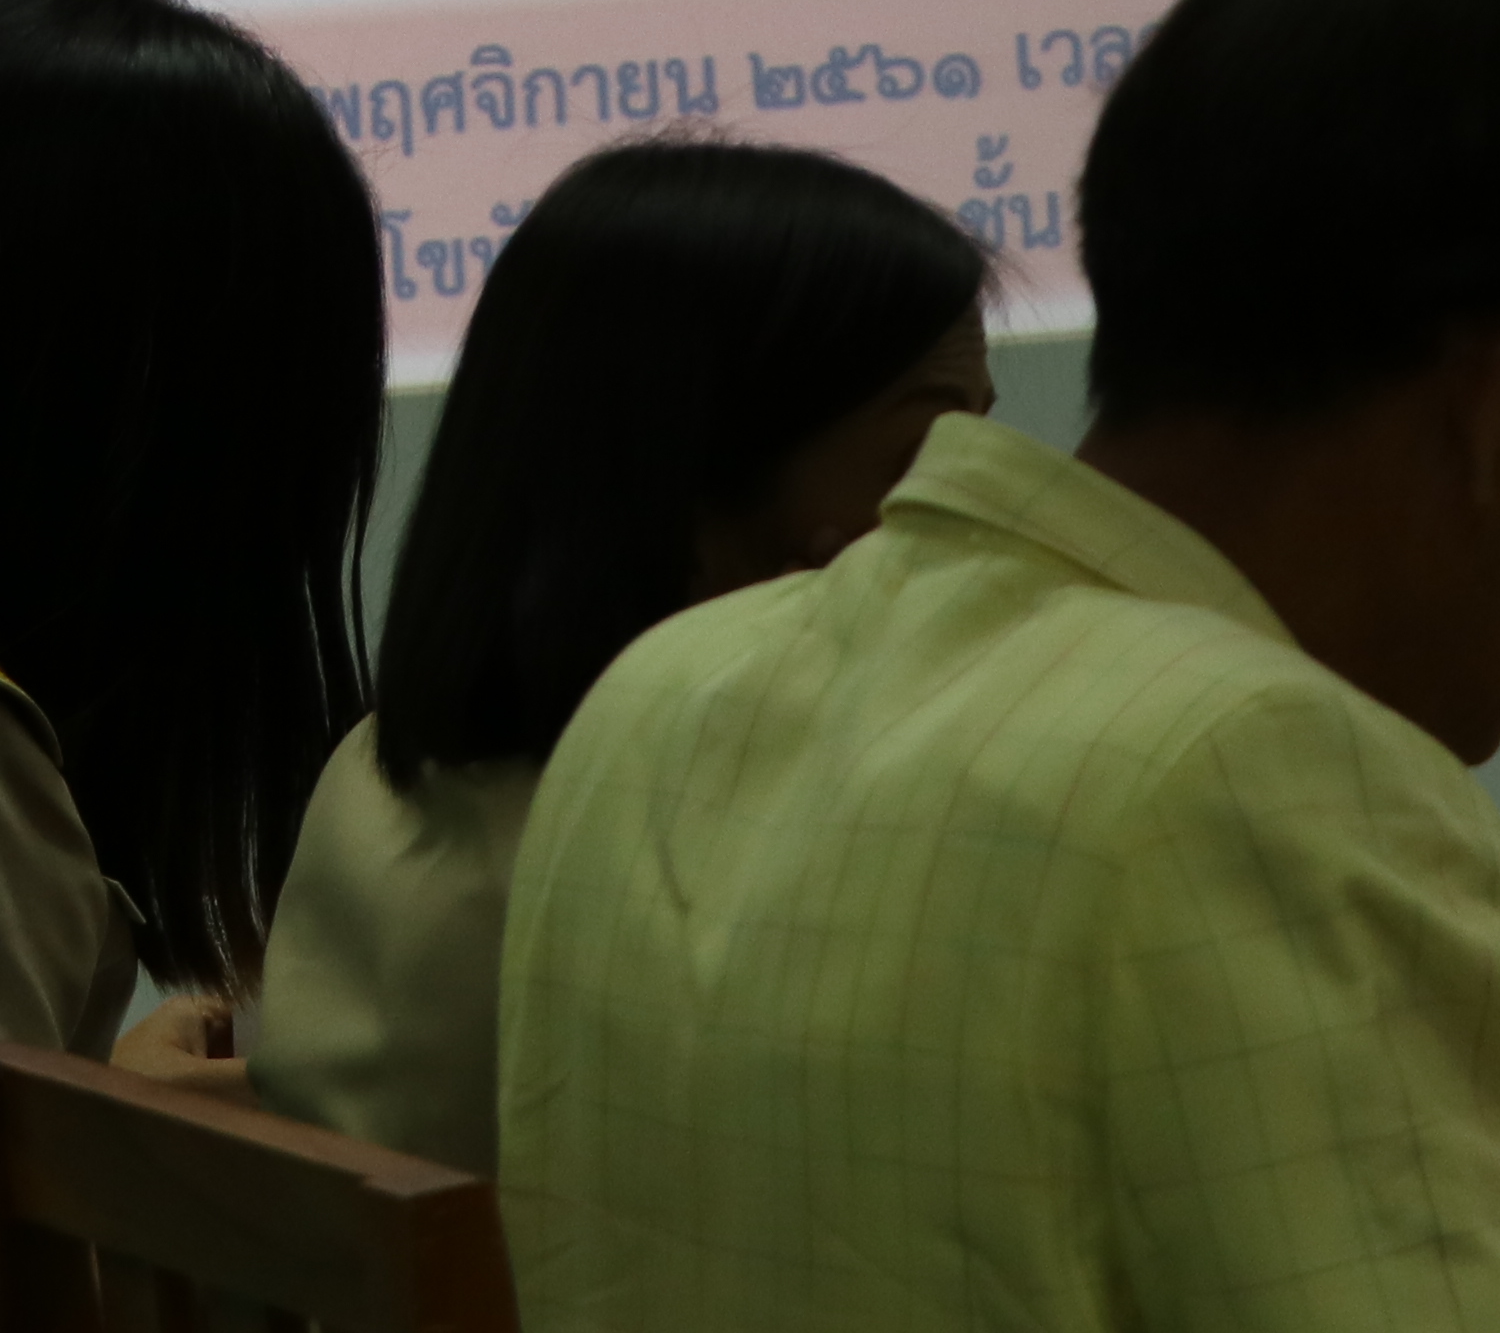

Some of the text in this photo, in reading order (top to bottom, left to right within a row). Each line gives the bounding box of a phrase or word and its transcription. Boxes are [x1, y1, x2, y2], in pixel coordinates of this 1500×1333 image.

[308, 43, 720, 158] พฤศจิกายน
[748, 41, 983, 113] ๒๕๖๑
[1014, 15, 1160, 91] เวล
